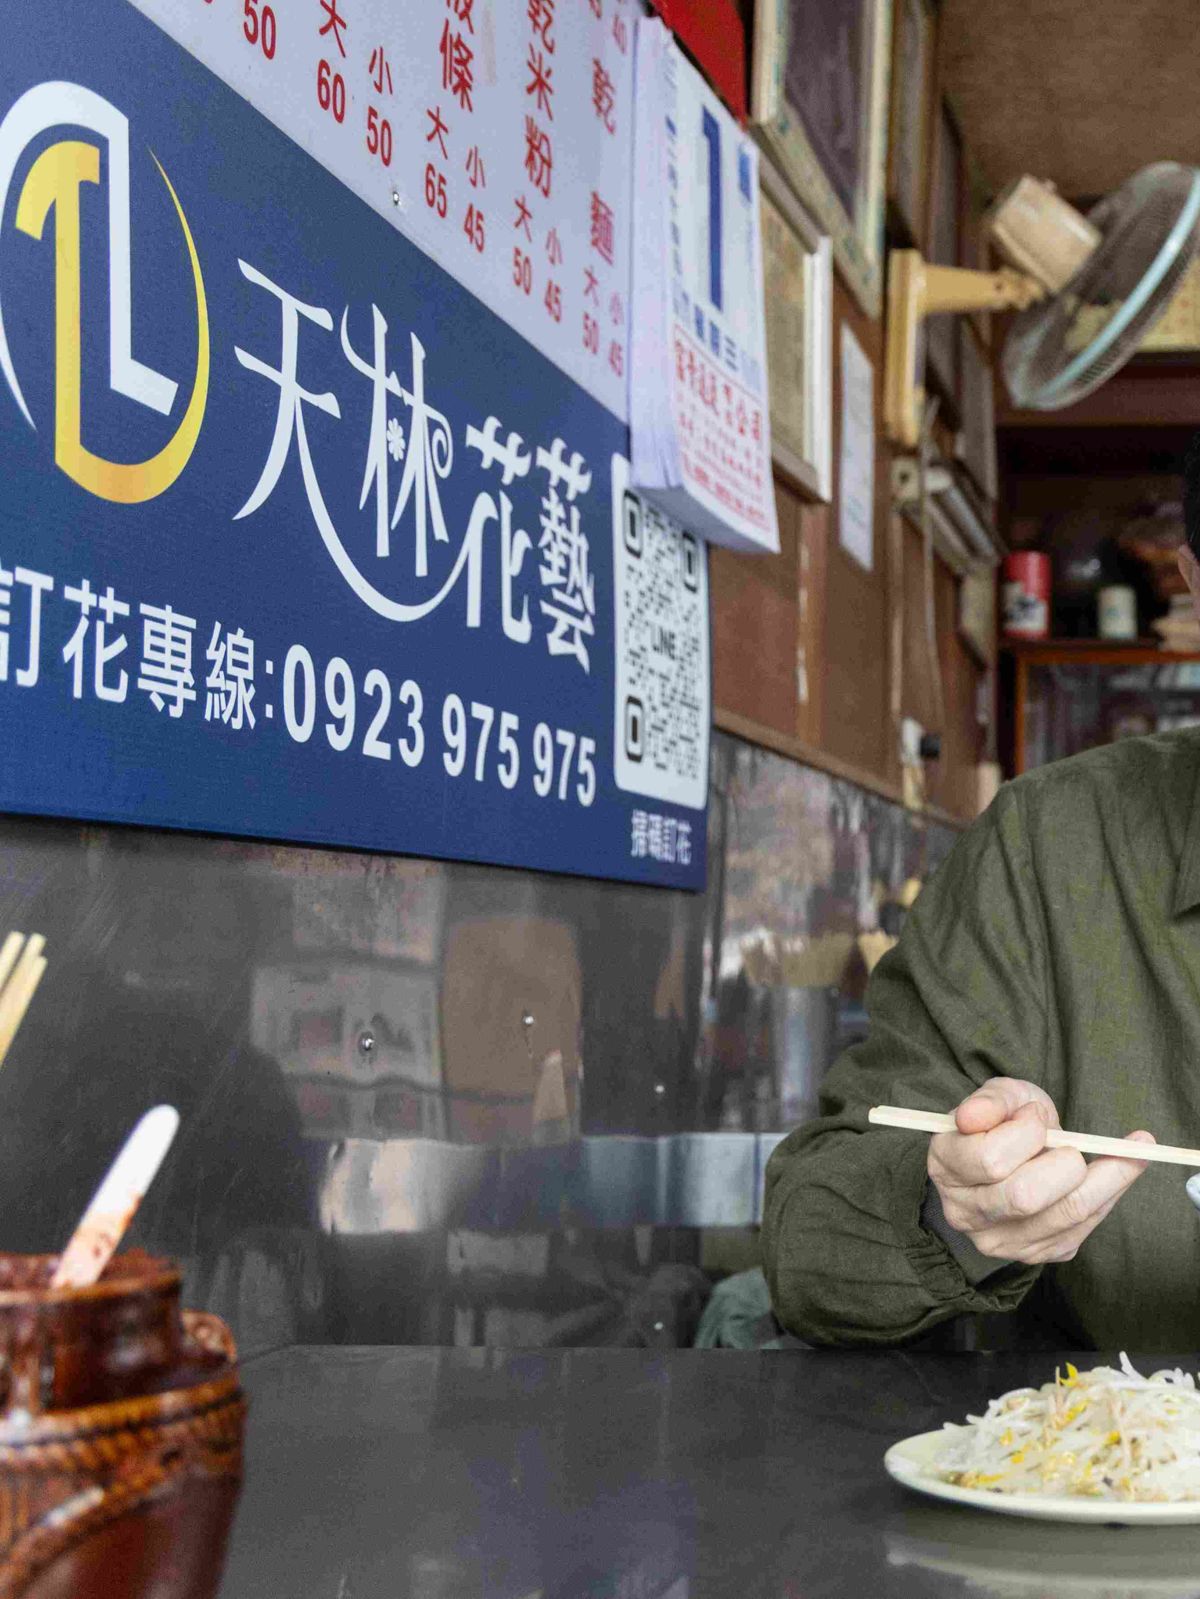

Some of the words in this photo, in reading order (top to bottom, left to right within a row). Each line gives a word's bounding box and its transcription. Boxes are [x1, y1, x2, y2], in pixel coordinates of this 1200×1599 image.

[243, 0, 277, 60] 50
[319, 0, 347, 58] 大
[317, 59, 346, 124] 60
[368, 46, 394, 94] 小
[366, 106, 393, 168] 50
[426, 105, 449, 160] 大
[425, 162, 448, 219] 65
[465, 145, 486, 188] 小
[464, 203, 485, 253] 45
[514, 186, 533, 243] 大
[513, 246, 532, 296] 50
[545, 226, 563, 265] 小
[544, 279, 562, 324] 45
[583, 265, 599, 306] 大
[442, 693, 520, 790] 975
[533, 722, 597, 808] 975
